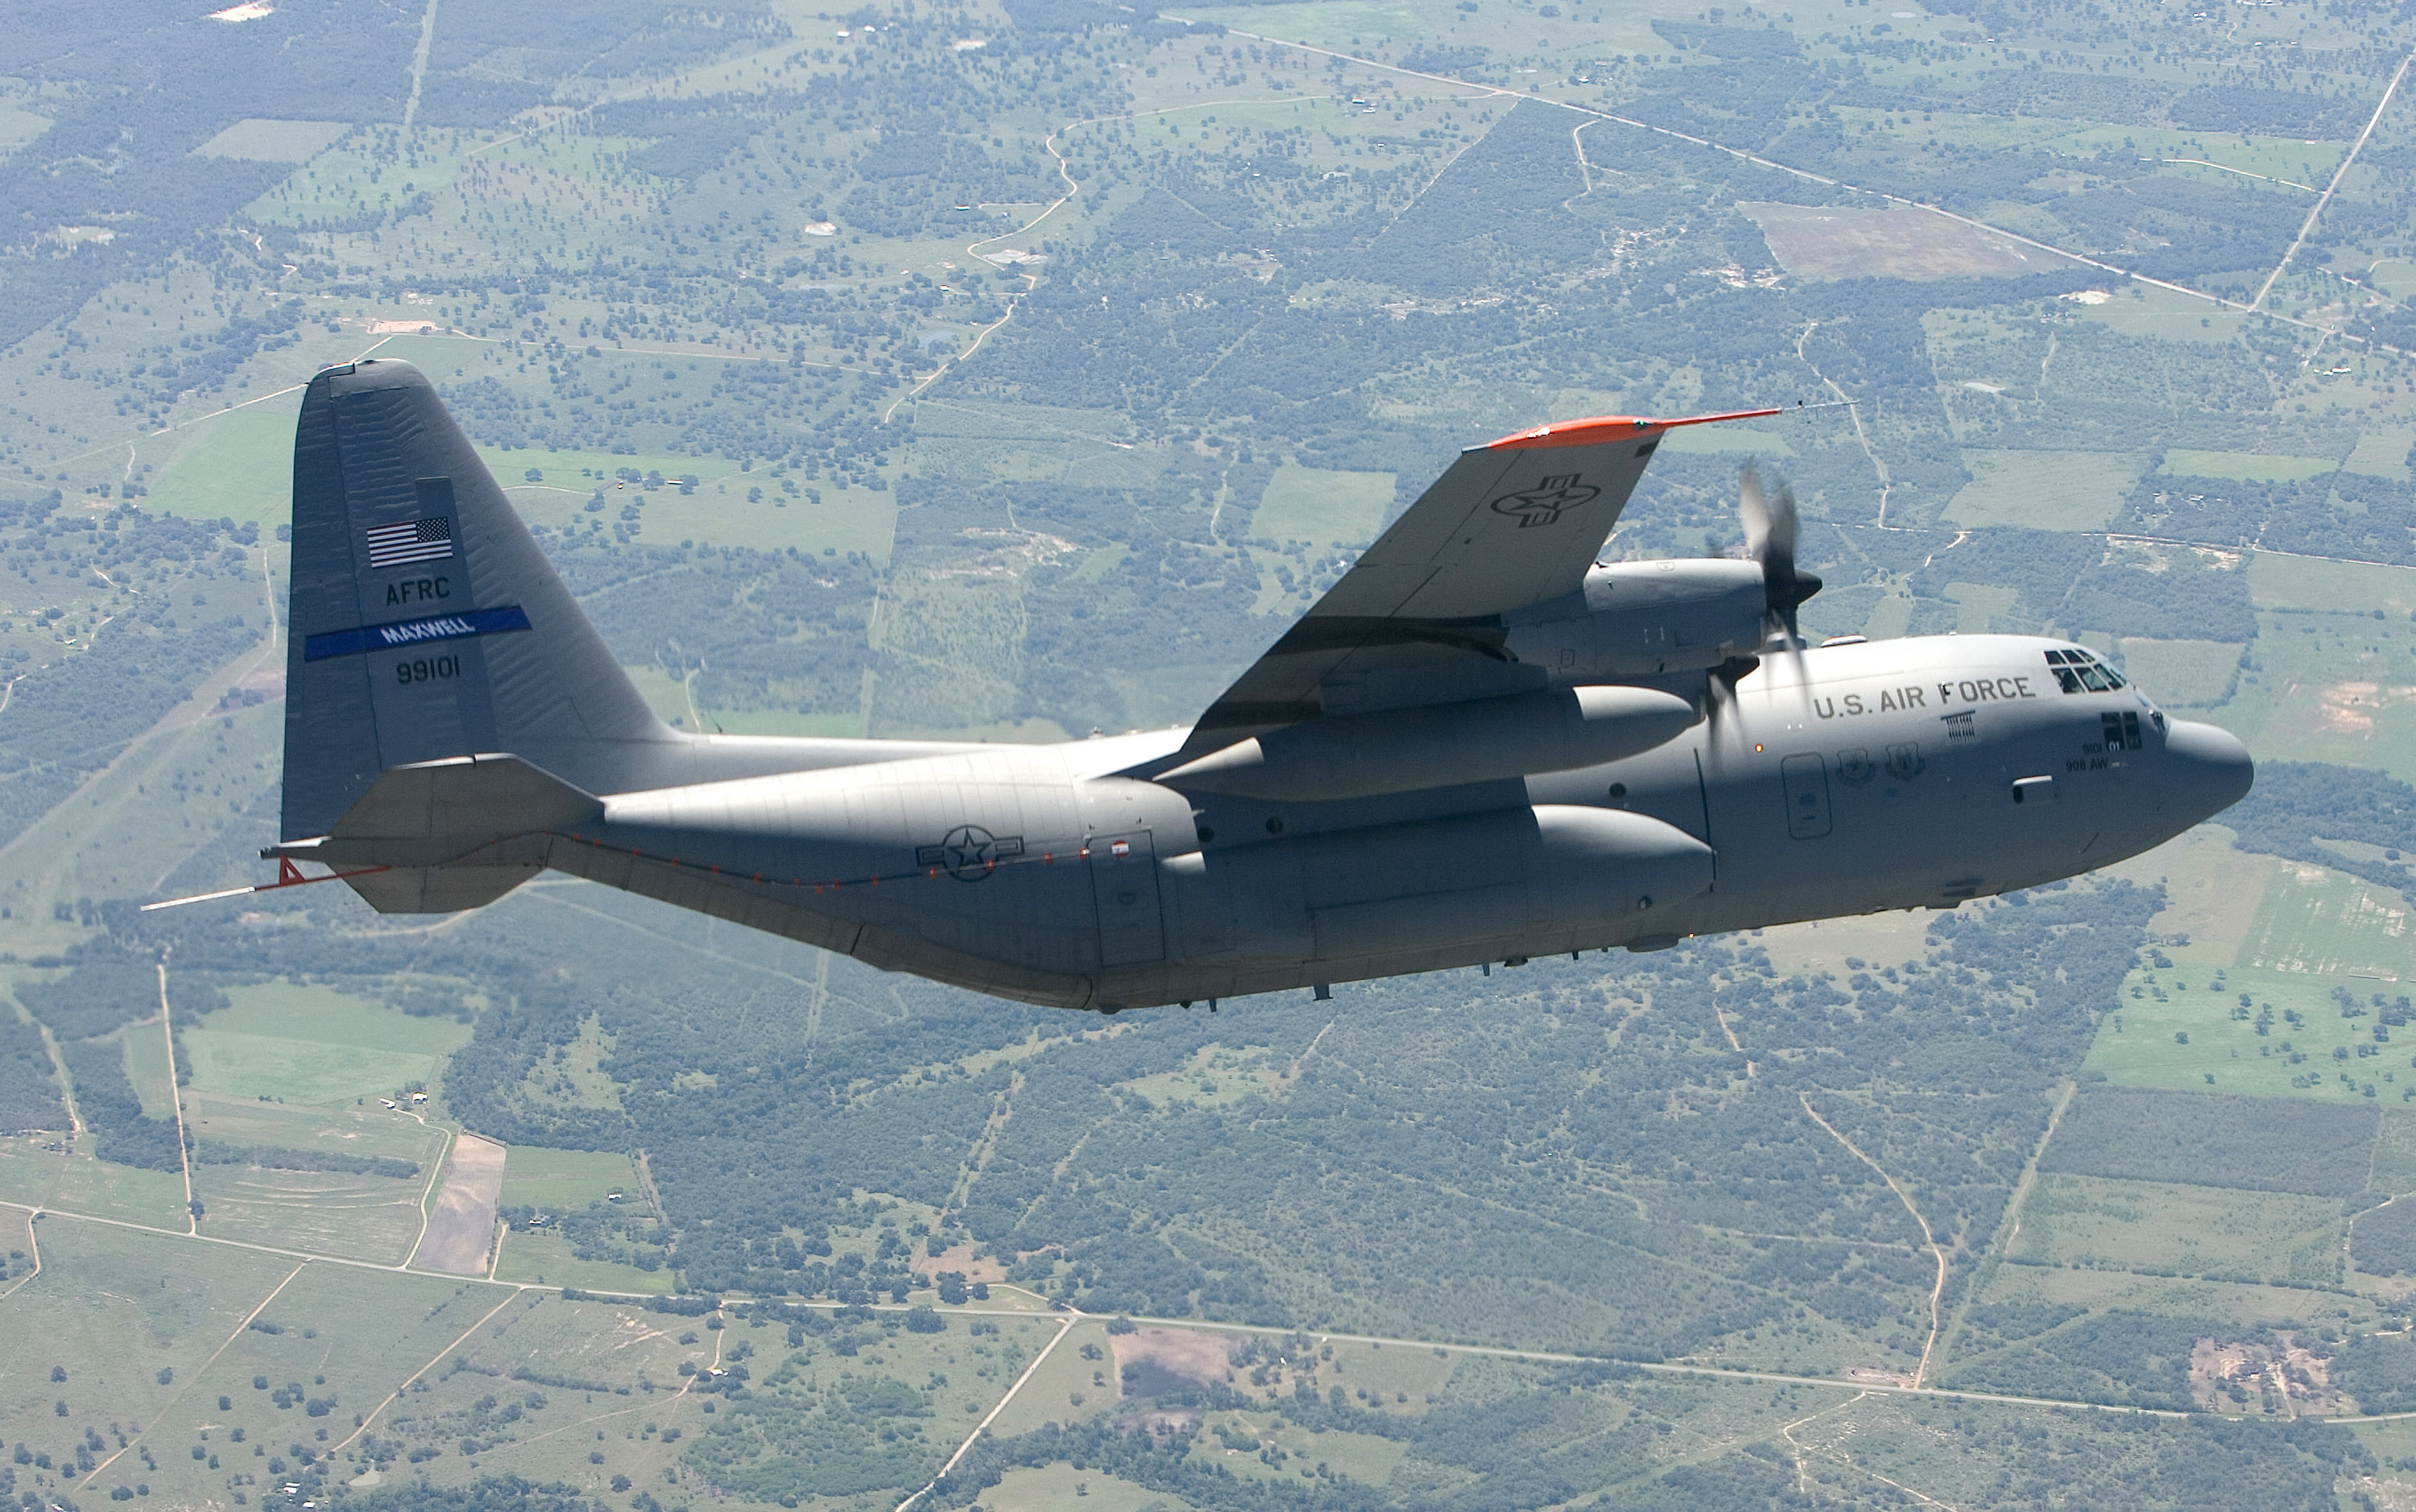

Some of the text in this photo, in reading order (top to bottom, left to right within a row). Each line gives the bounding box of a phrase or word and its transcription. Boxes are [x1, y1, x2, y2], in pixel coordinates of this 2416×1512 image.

[387, 576, 450, 606] AFRC
[380, 617, 476, 644] MAXWELL
[396, 655, 460, 684] 99101
[1814, 677, 2036, 719] U.S. AIR FORCE
[2090, 757, 2108, 770] AW
